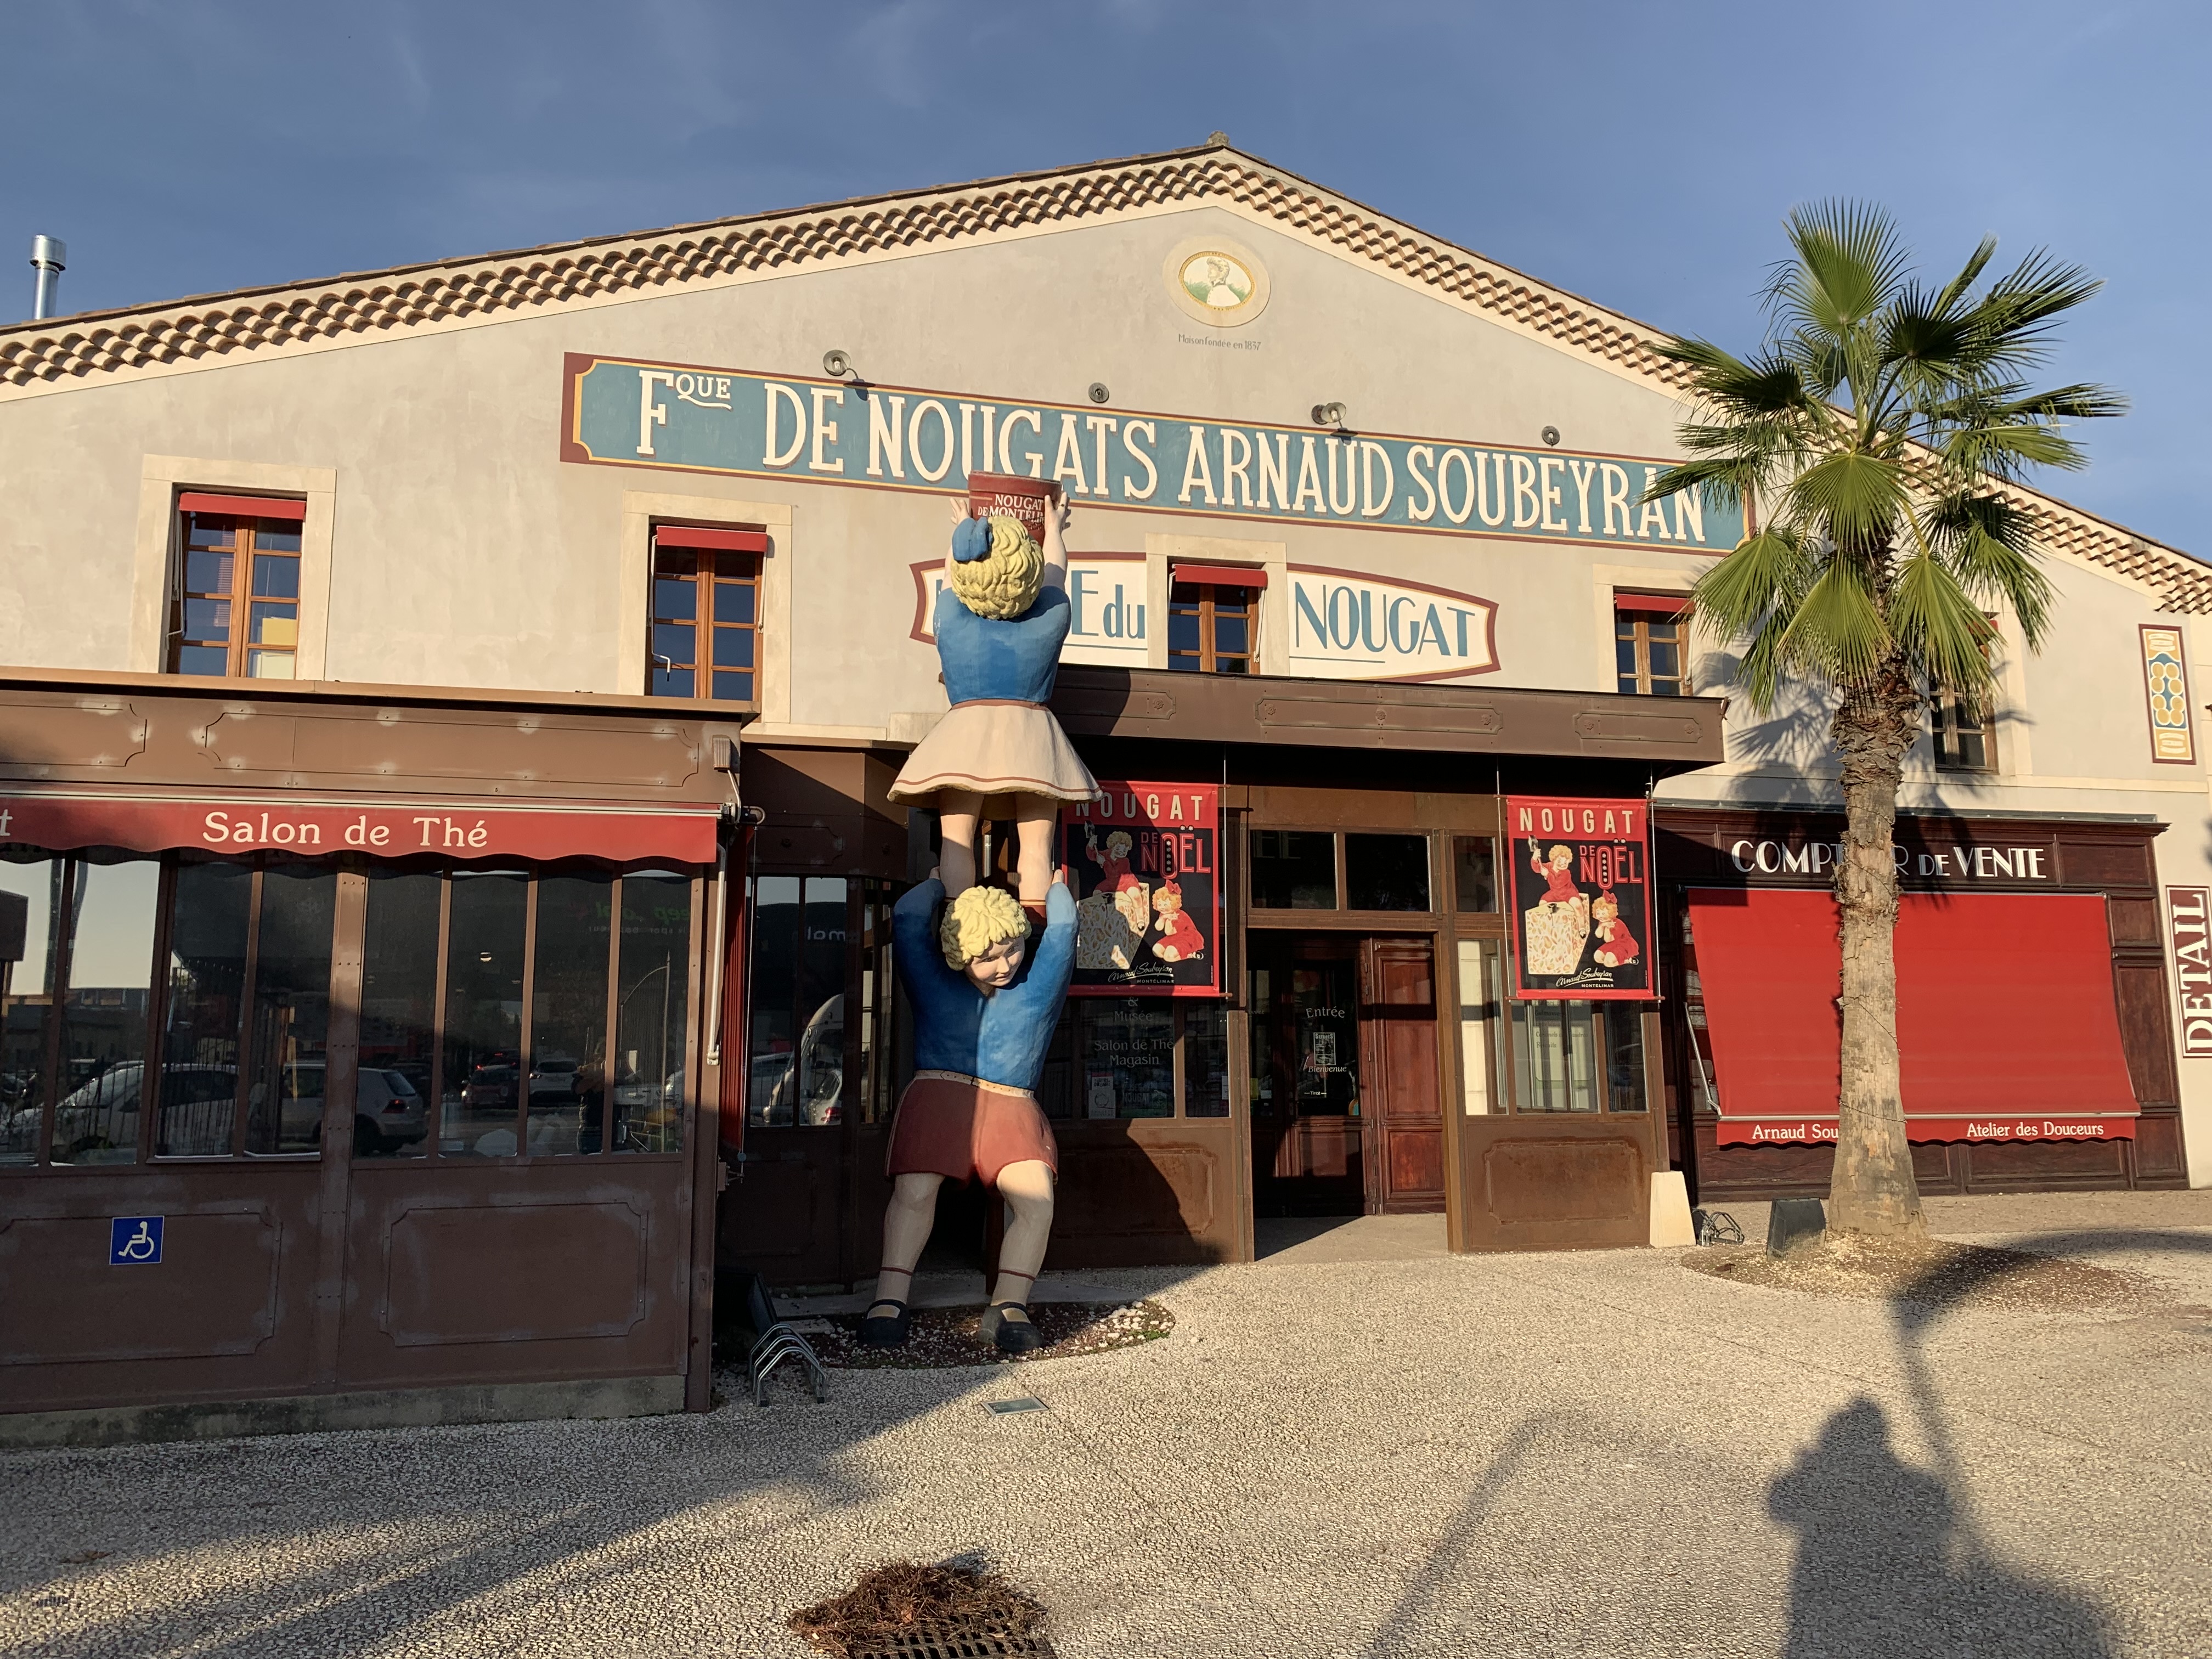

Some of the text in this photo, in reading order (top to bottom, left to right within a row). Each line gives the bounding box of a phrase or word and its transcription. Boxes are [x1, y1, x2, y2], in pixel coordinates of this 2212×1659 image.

[1178, 333, 1262, 351] Maison fondée en 1837
[763, 382, 845, 475] DE
[867, 393, 1158, 501] NOUGATS
[1178, 426, 1394, 517] ARNAUD
[978, 506, 988, 516] DE
[995, 494, 1043, 511] NOUGAT
[1103, 584, 1145, 640] du
[1295, 582, 1476, 658] NOUGAT
[1076, 793, 1203, 821] NOUGAT
[1520, 807, 1633, 834] NOUGAT
[202, 811, 488, 848] Salon de Thé
[1141, 832, 1158, 843] DE
[1141, 825, 1211, 879] NOËL
[1579, 845, 1595, 857] DE
[1731, 839, 2047, 879] COMPTR DE VENTE
[1579, 838, 1643, 890] NOËL
[1114, 1011, 1153, 1022] Musée
[1306, 1006, 1346, 1019] Entrée
[1094, 1039, 1175, 1051] Salon de Thé
[1109, 1053, 1159, 1068] Magasin
[1308, 1065, 1347, 1074] Bienvenue
[1752, 1124, 1806, 1139] Arnaud
[1967, 1121, 2104, 1137] Atelier des Douceurs
